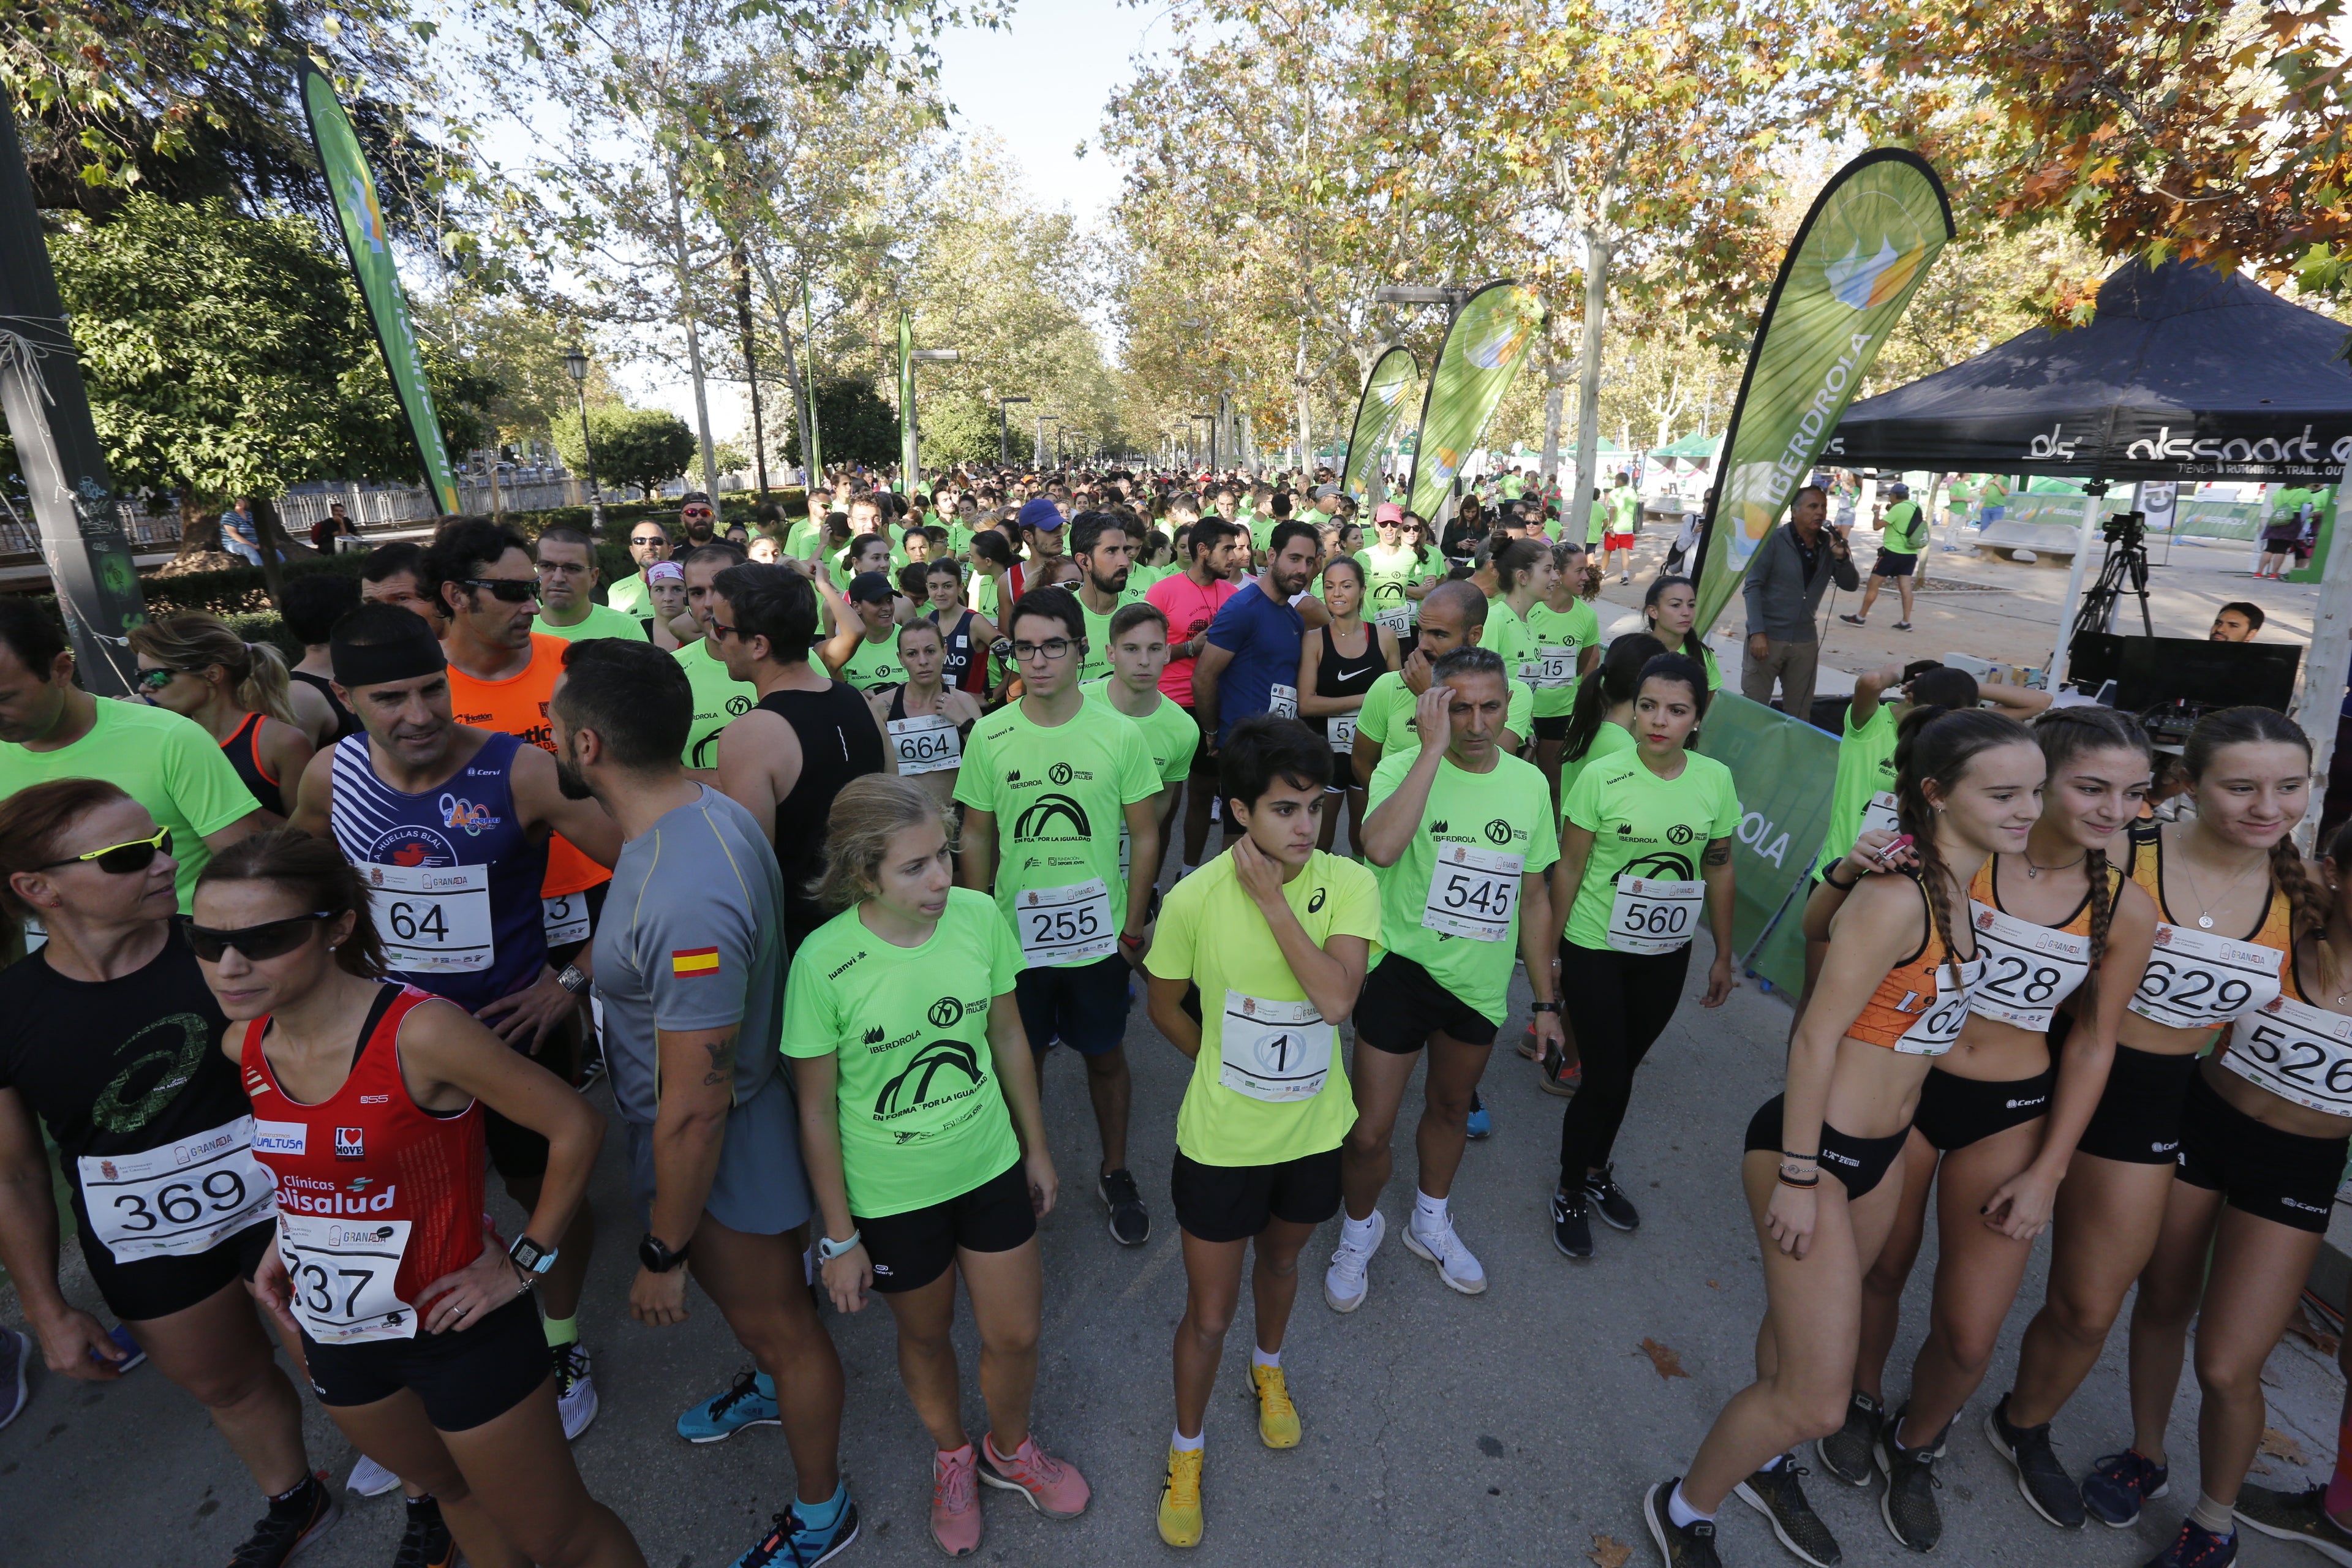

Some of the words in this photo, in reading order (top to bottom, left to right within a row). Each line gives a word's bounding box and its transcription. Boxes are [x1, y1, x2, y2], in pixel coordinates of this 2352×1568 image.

[1760, 333, 1872, 507] IBERDROLA
[1359, 413, 1395, 480] IBERDROLA
[2177, 464, 2215, 473] TIENDA
[2226, 464, 2276, 475] RUNNING
[2285, 465, 2316, 475] TRAIL
[693, 712, 718, 721] RDROLA
[1277, 703, 1298, 720] 51
[987, 728, 1008, 741] luanvi
[900, 733, 949, 759] 664
[1607, 773, 1627, 785] luanvi
[378, 831, 418, 851] HUELLAS
[433, 876, 468, 886] GRANADA
[1074, 886, 1095, 897] GRANADA
[1445, 875, 1511, 916] 545
[391, 902, 449, 942] 64
[1033, 906, 1098, 942] 255
[1625, 903, 1687, 933] 560
[2048, 940, 2080, 955] GRANADA
[2231, 950, 2265, 965] GRANADA
[828, 956, 856, 980] luanvi
[2139, 960, 2252, 1012] 629
[965, 998, 987, 1008] UNIVERSO
[966, 1003, 987, 1014] MUJER
[1303, 1005, 1319, 1017] GRAN
[870, 1030, 921, 1054] IBERDROLA
[1271, 1035, 1287, 1072] 1
[2248, 1025, 2352, 1093] 526
[167, 1079, 187, 1088] ADDICT
[886, 1106, 917, 1120] FORMA
[941, 1095, 952, 1105] LA
[2017, 1096, 2045, 1107] Cervi
[190, 1134, 233, 1157] GRANADA
[336, 1145, 364, 1155] MOVE
[284, 1175, 335, 1191] Clínicas
[114, 1170, 246, 1231] 369
[2296, 1202, 2328, 1215] Cervi
